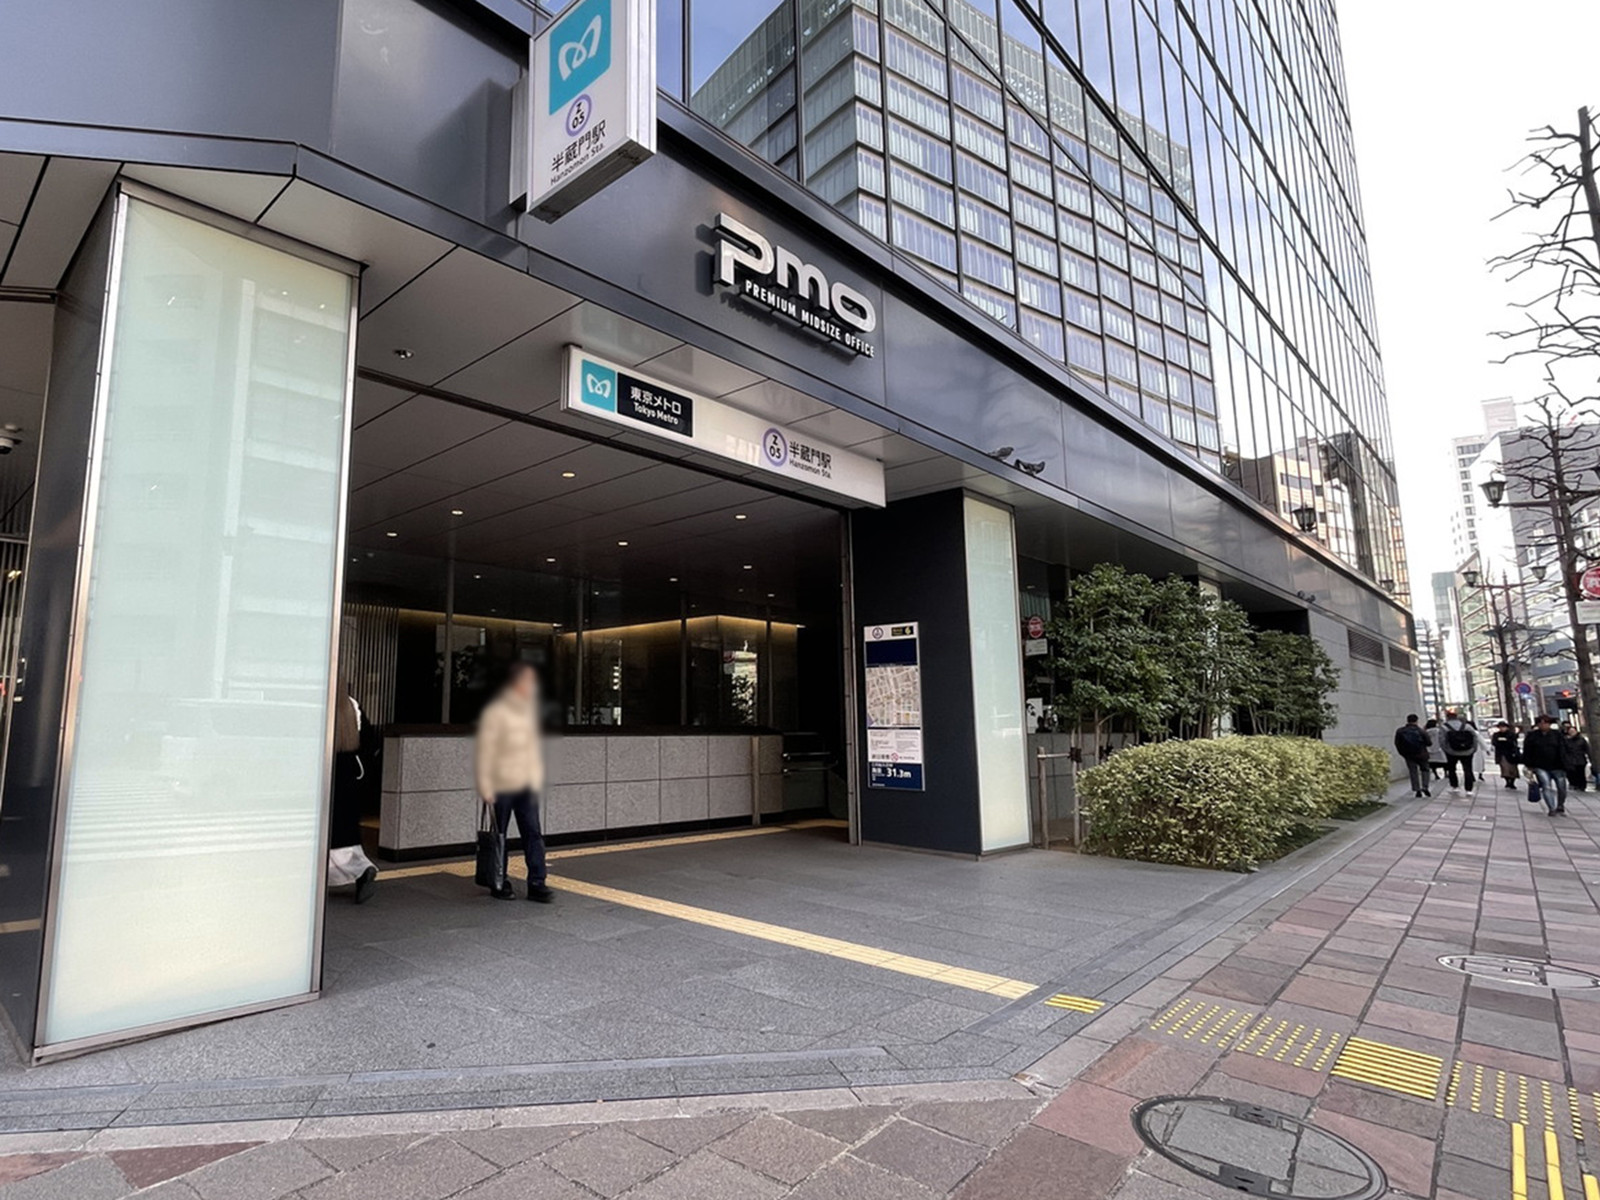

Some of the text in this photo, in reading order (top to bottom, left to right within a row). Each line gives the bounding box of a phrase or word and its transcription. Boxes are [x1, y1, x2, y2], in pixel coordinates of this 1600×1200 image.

[575, 101, 582, 114] Z
[572, 112, 585, 129] 05
[551, 119, 606, 172] 半蔵門駅
[550, 154, 590, 186] Hanzomon
[745, 279, 875, 357] PREMIUM MIDSIZE OFFICE
[630, 386, 682, 415] 東京メトロ
[633, 401, 679, 425] Tokyo Metro
[772, 434, 779, 446] Z
[769, 446, 782, 459] 05
[789, 441, 832, 470] 半蔵門駅
[789, 458, 821, 476] Hanzomon
